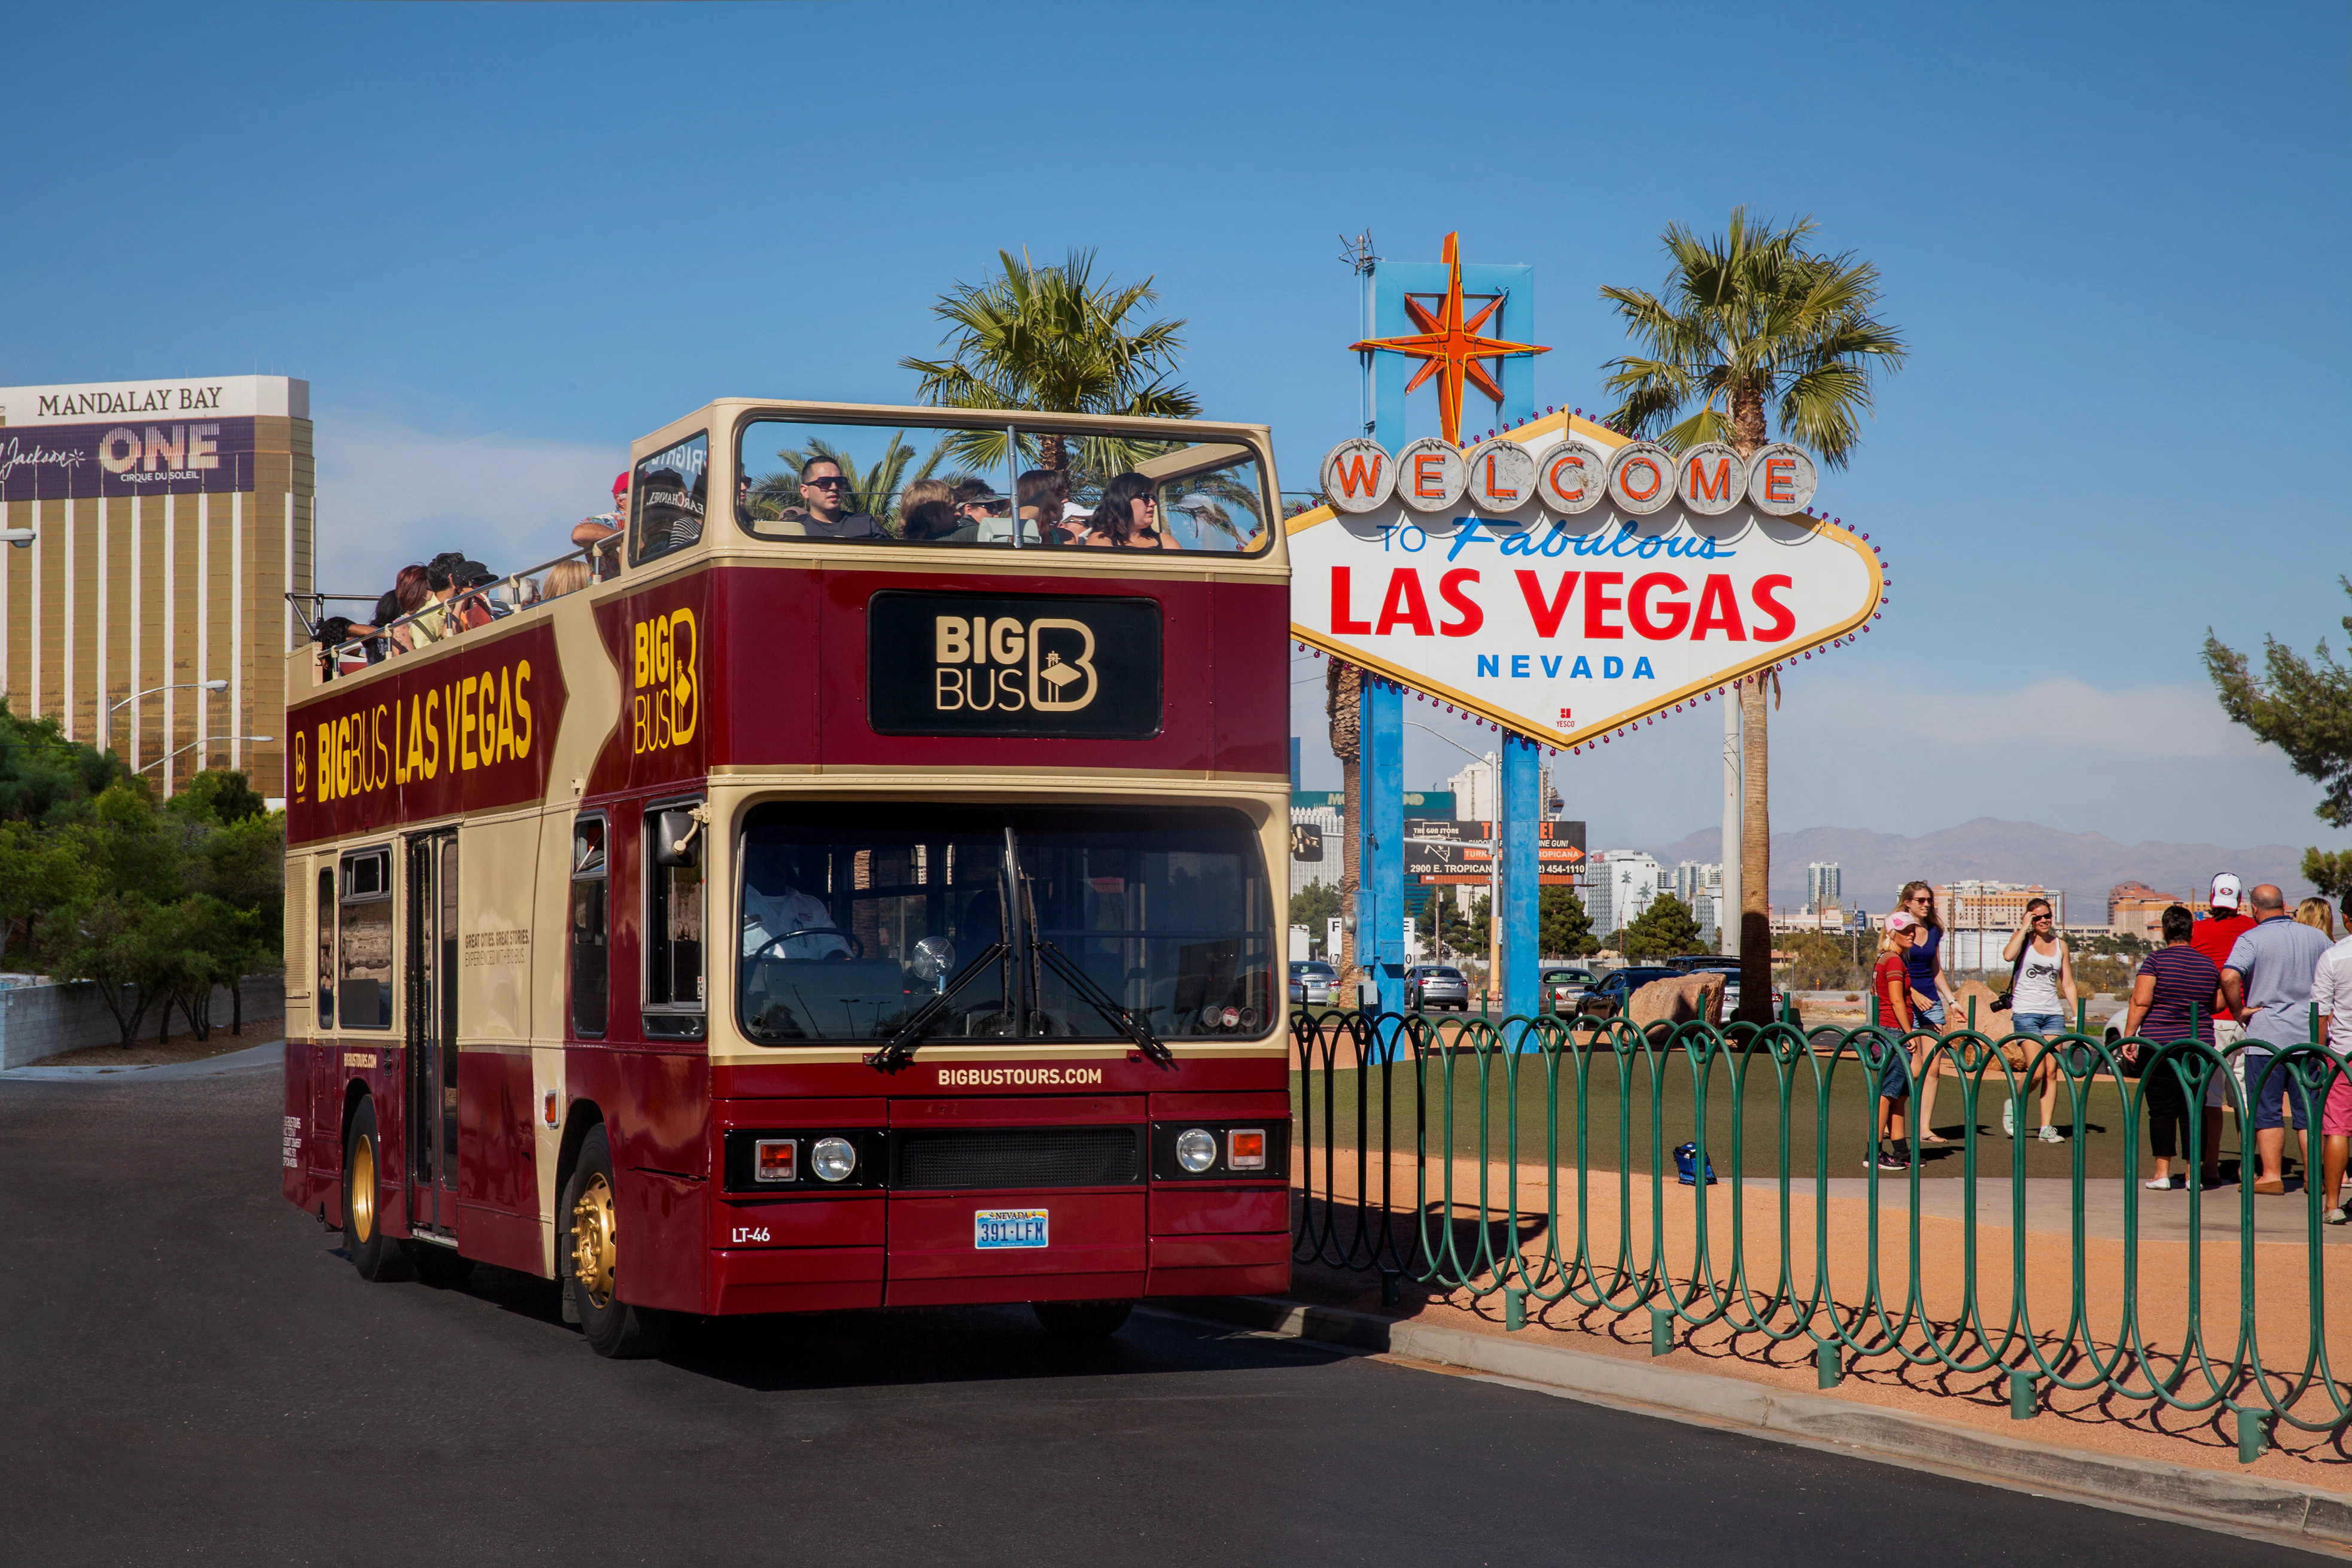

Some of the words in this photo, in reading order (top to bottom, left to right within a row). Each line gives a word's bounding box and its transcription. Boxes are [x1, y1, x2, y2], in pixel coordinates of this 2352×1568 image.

[38, 389, 172, 416] MANDALAY
[179, 387, 223, 409] BAY
[4, 437, 73, 480] Jackson
[99, 424, 219, 473] ONE
[120, 473, 153, 483] CIRQUE
[155, 472, 168, 480] DU
[169, 471, 199, 479] SOLEIL
[1335, 453, 1796, 501] WELCOME
[1377, 525, 1426, 552] TO
[1447, 516, 1737, 562] Fabulous
[1331, 566, 1484, 638] LAS
[1514, 570, 1796, 643] VEGAS
[635, 615, 669, 689] BIG
[936, 616, 1025, 665] BIG
[1478, 654, 1655, 679] NEVADA
[936, 668, 1026, 711] BUS
[395, 689, 439, 785] LAS
[445, 660, 532, 774] VEGAS
[635, 689, 670, 754] BUS
[1410, 864, 1431, 873] 2900
[1433, 864, 1443, 873] E.
[1444, 864, 1492, 873] TROPICAN
[1546, 864, 1585, 873] 454-1110
[465, 933, 480, 949] GREAT
[496, 931, 509, 946] GREAT
[938, 1068, 1102, 1085] BIGBUSTOURS.COM
[732, 1227, 771, 1243] LT-46
[995, 1211, 1029, 1220] NEVADA
